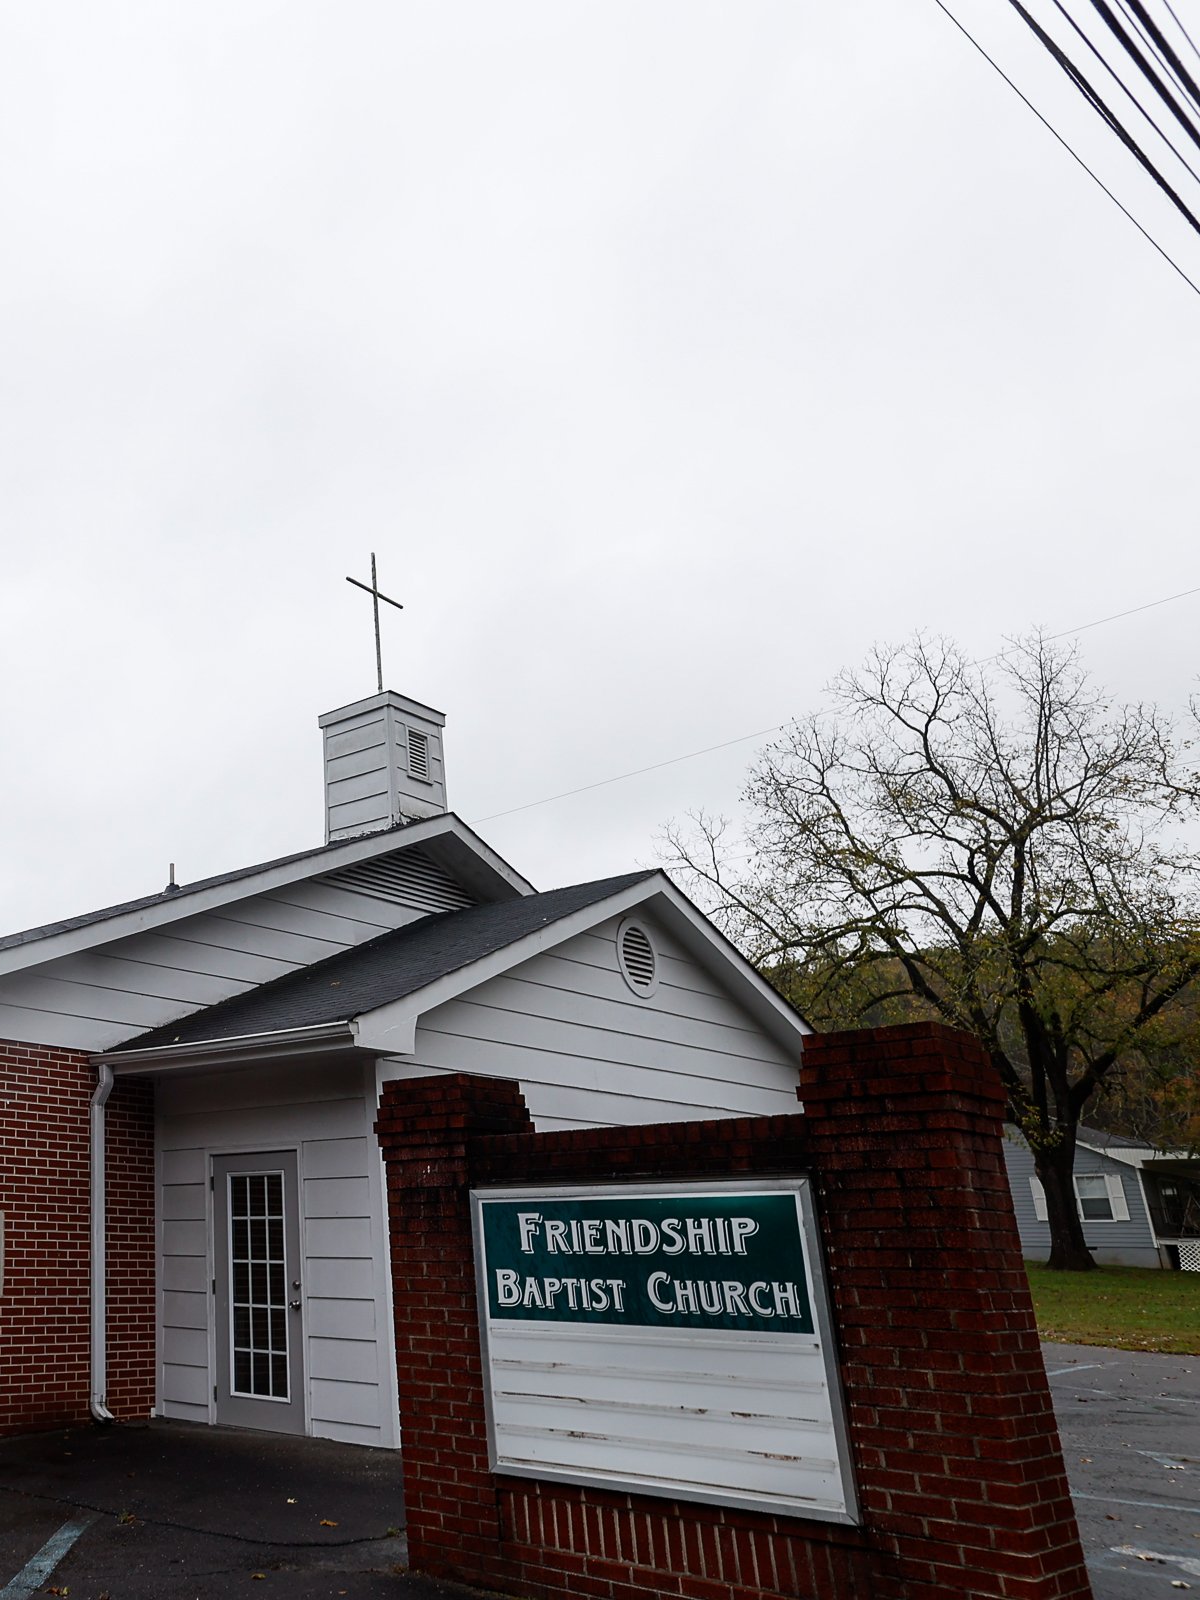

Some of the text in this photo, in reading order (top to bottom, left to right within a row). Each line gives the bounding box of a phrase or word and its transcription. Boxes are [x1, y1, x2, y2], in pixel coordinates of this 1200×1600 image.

[517, 1213, 759, 1255] FRIENDSHIP
[496, 1269, 802, 1318] BAPTIST CHURCH
